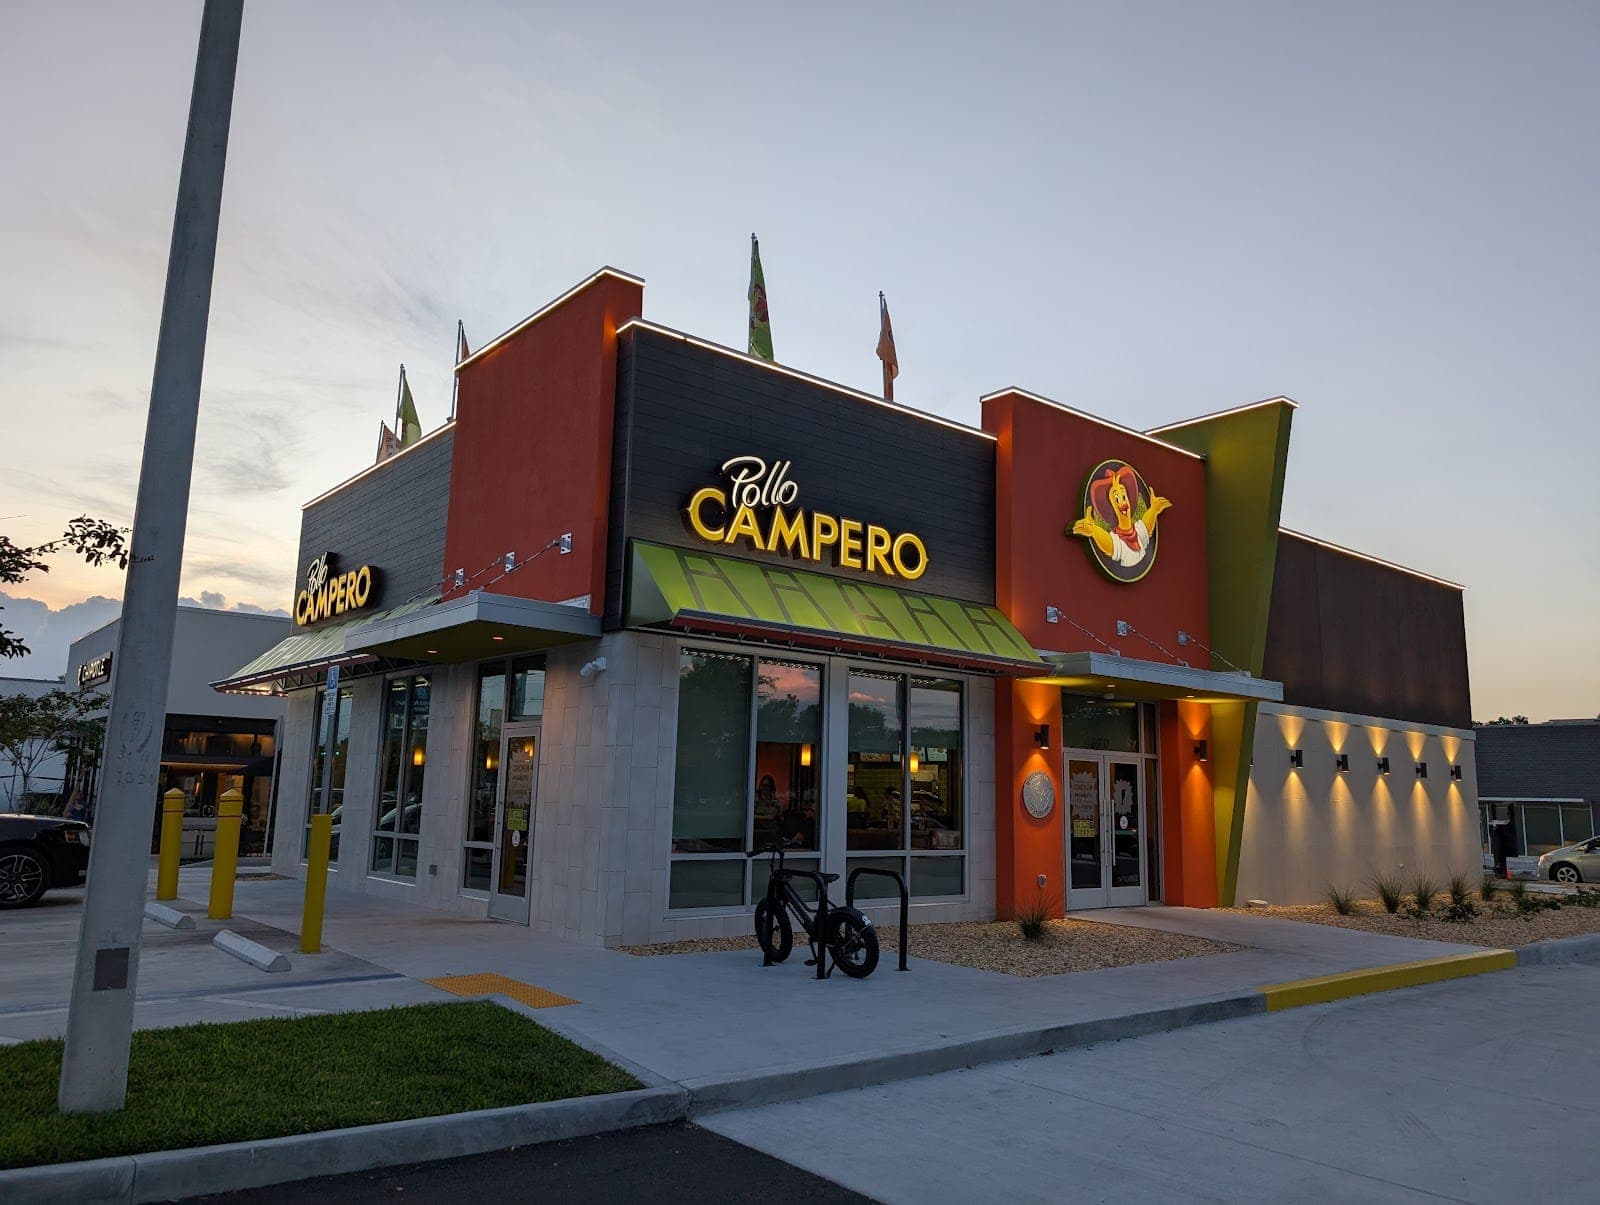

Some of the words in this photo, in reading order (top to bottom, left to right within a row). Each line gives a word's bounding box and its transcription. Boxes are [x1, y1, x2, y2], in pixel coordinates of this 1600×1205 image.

[721, 456, 798, 508] Pollo
[686, 487, 929, 580] CAMPERO
[296, 565, 372, 625] CAMPERO
[307, 551, 328, 595] Pollo
